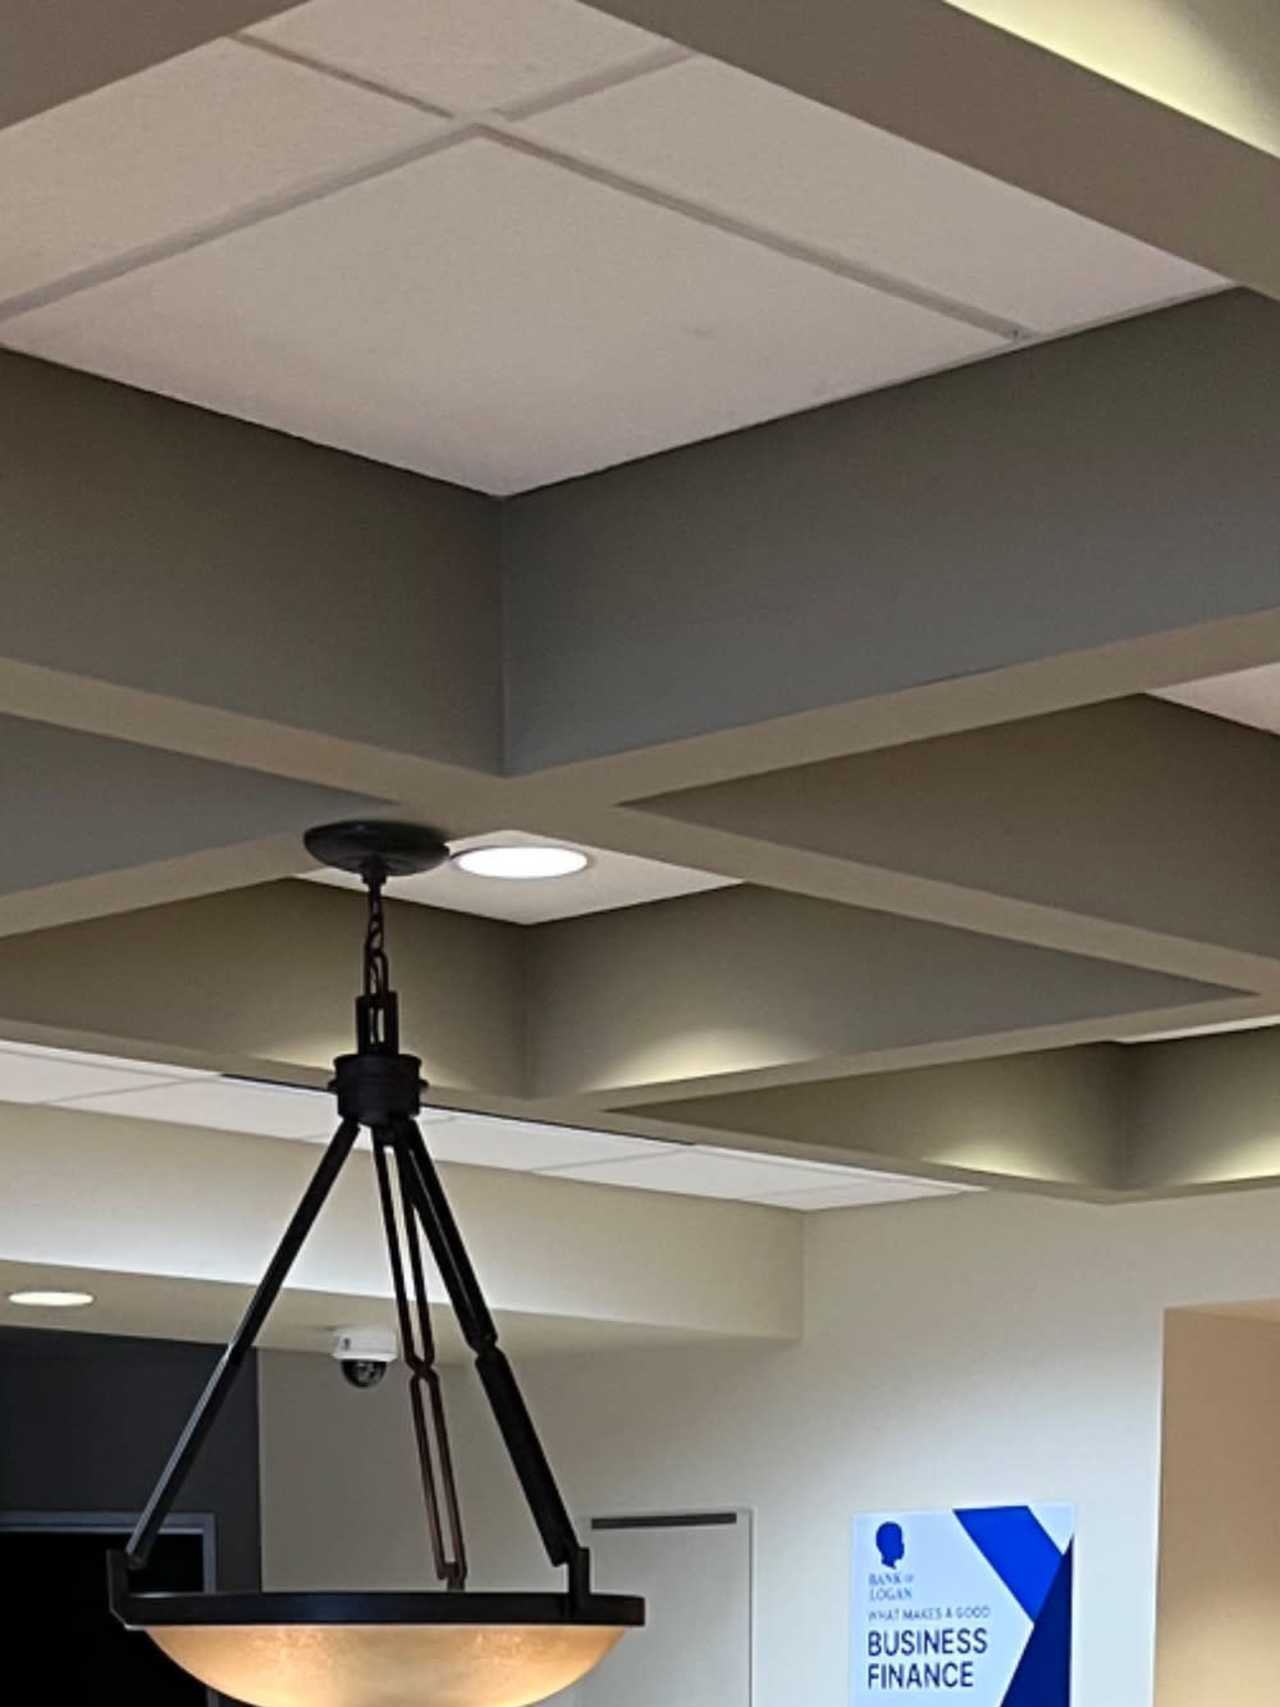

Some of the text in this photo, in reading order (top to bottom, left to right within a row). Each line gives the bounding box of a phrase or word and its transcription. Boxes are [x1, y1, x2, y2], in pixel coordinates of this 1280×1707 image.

[870, 1587, 912, 1600] LOGAN
[868, 1605, 990, 1621] WHAT MAKES A GOOD
[868, 1627, 988, 1656] BUSINESS
[868, 1661, 973, 1689] FINANCE
